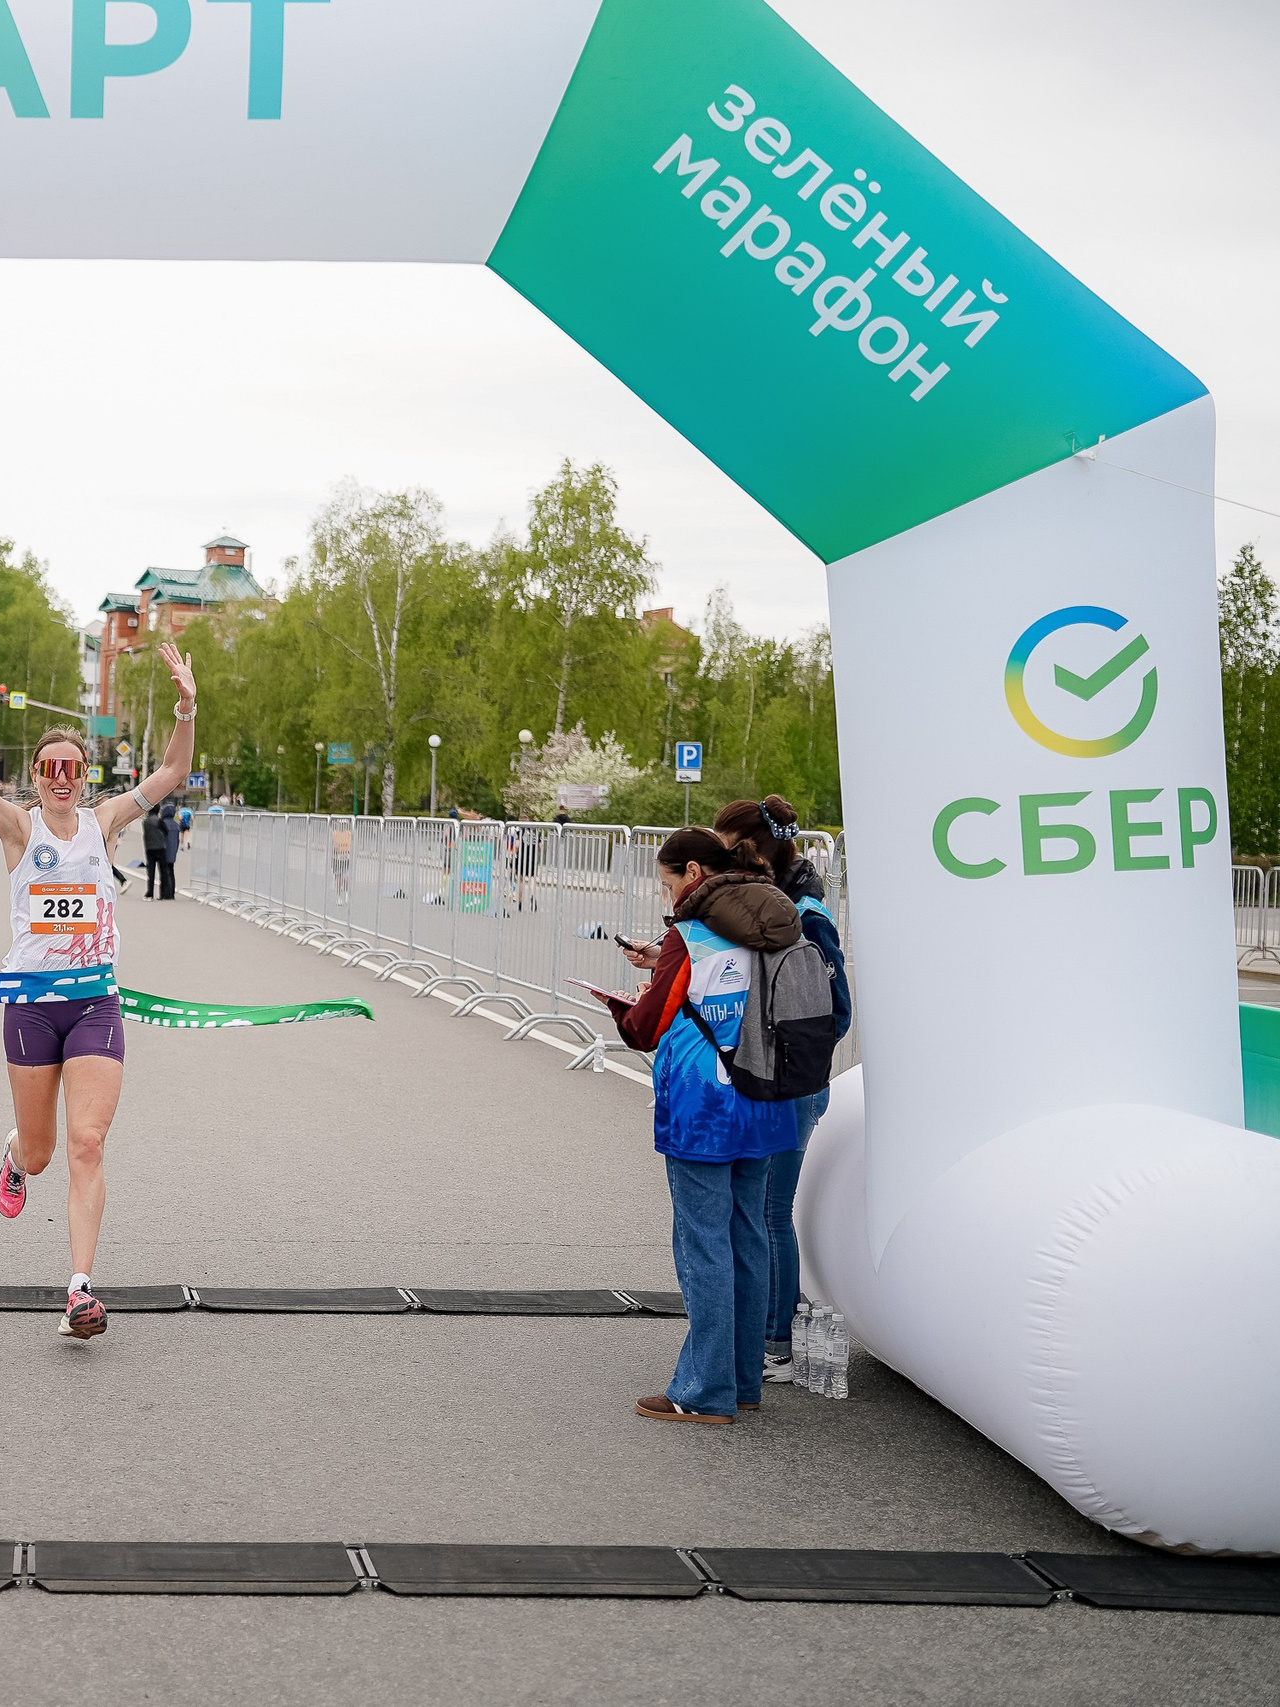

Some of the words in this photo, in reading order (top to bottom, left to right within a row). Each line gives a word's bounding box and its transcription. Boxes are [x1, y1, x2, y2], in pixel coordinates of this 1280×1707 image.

[707, 84, 1009, 348] зелёный
[652, 133, 951, 402] марафон
[683, 746, 697, 767] P
[932, 787, 1217, 880] СБЕР
[43, 899, 84, 918] 282
[700, 1000, 744, 1021] АНТЫ-М
